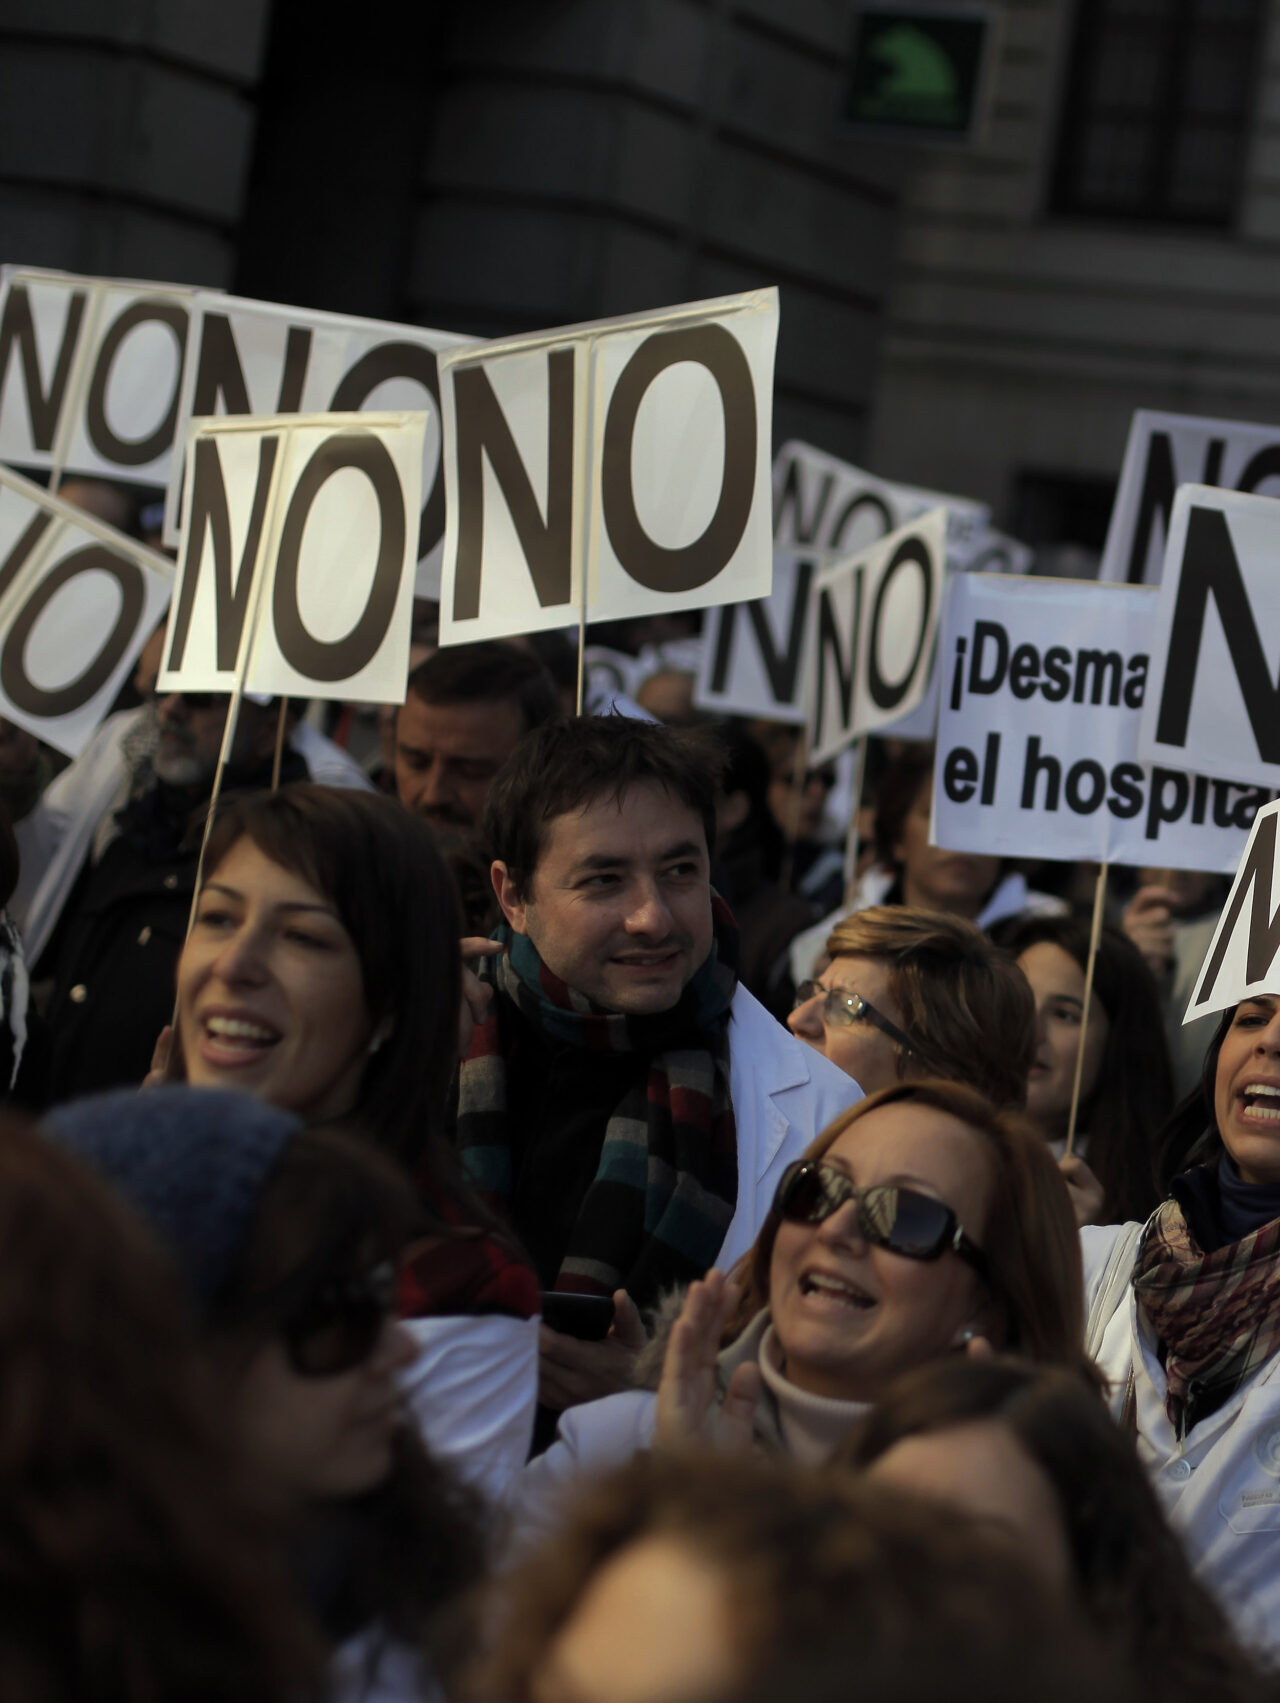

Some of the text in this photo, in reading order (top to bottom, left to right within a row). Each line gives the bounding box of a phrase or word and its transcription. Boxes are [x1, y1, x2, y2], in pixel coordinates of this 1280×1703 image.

[0, 284, 190, 466] NO
[452, 322, 757, 593] NO
[168, 430, 408, 682] NO
[812, 535, 933, 749] NO
[943, 732, 1000, 805] el
